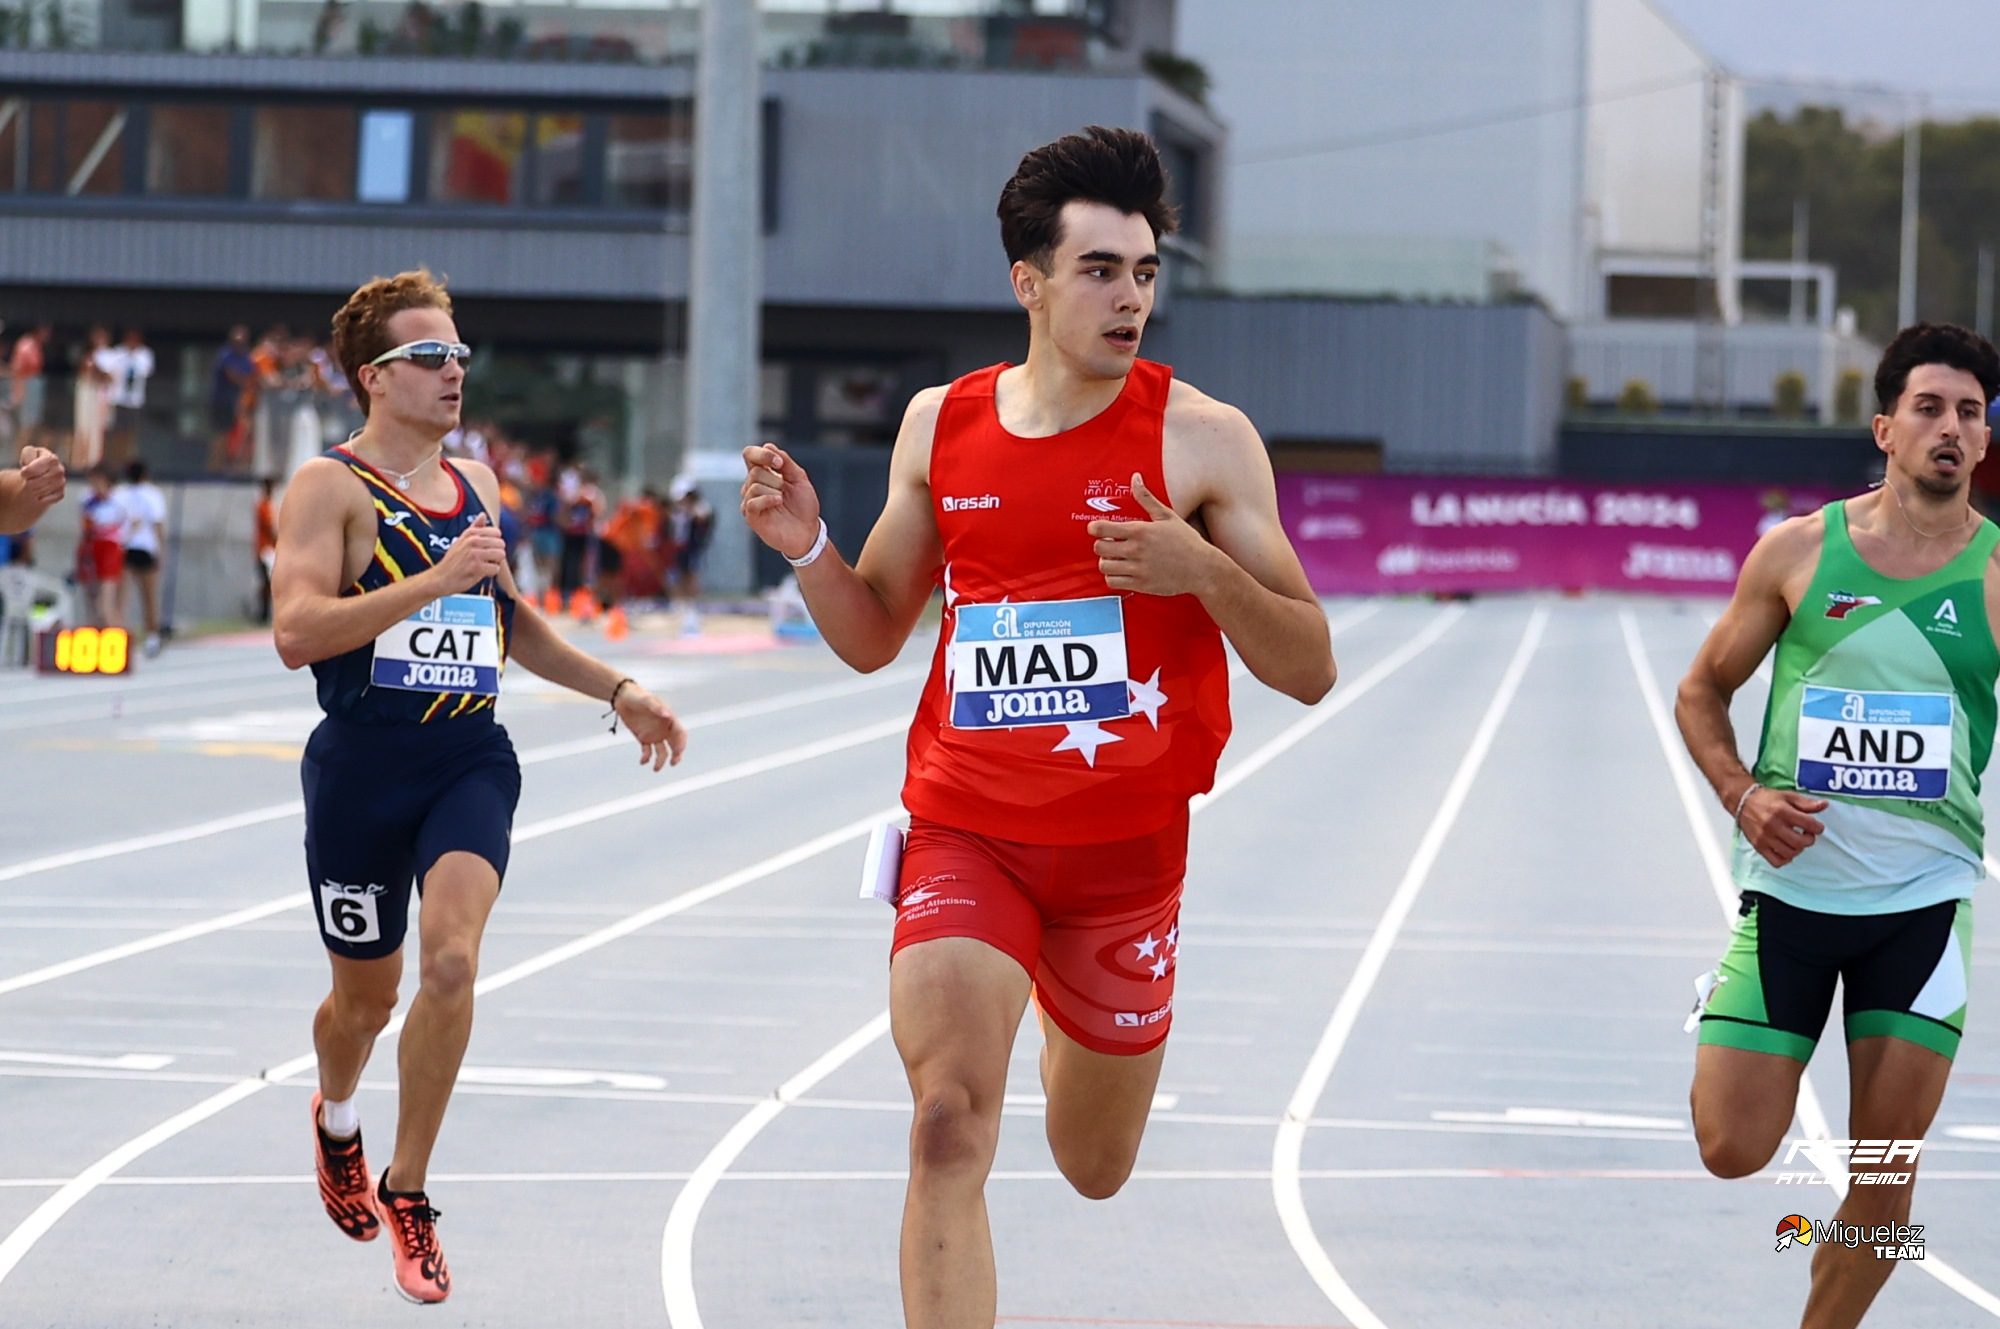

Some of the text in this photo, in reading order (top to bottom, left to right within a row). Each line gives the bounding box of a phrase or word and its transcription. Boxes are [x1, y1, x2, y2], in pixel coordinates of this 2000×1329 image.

[1023, 619, 1072, 629] DIPUTACIÓN
[1036, 628, 1072, 636] ALICANTE
[55, 626, 128, 674] 100
[408, 627, 481, 661] CAT
[975, 642, 1099, 687] MAD
[1824, 726, 1925, 764] AND
[331, 898, 367, 937] 6
[906, 907, 939, 923] Madrid
[926, 897, 977, 908] Atletismo
